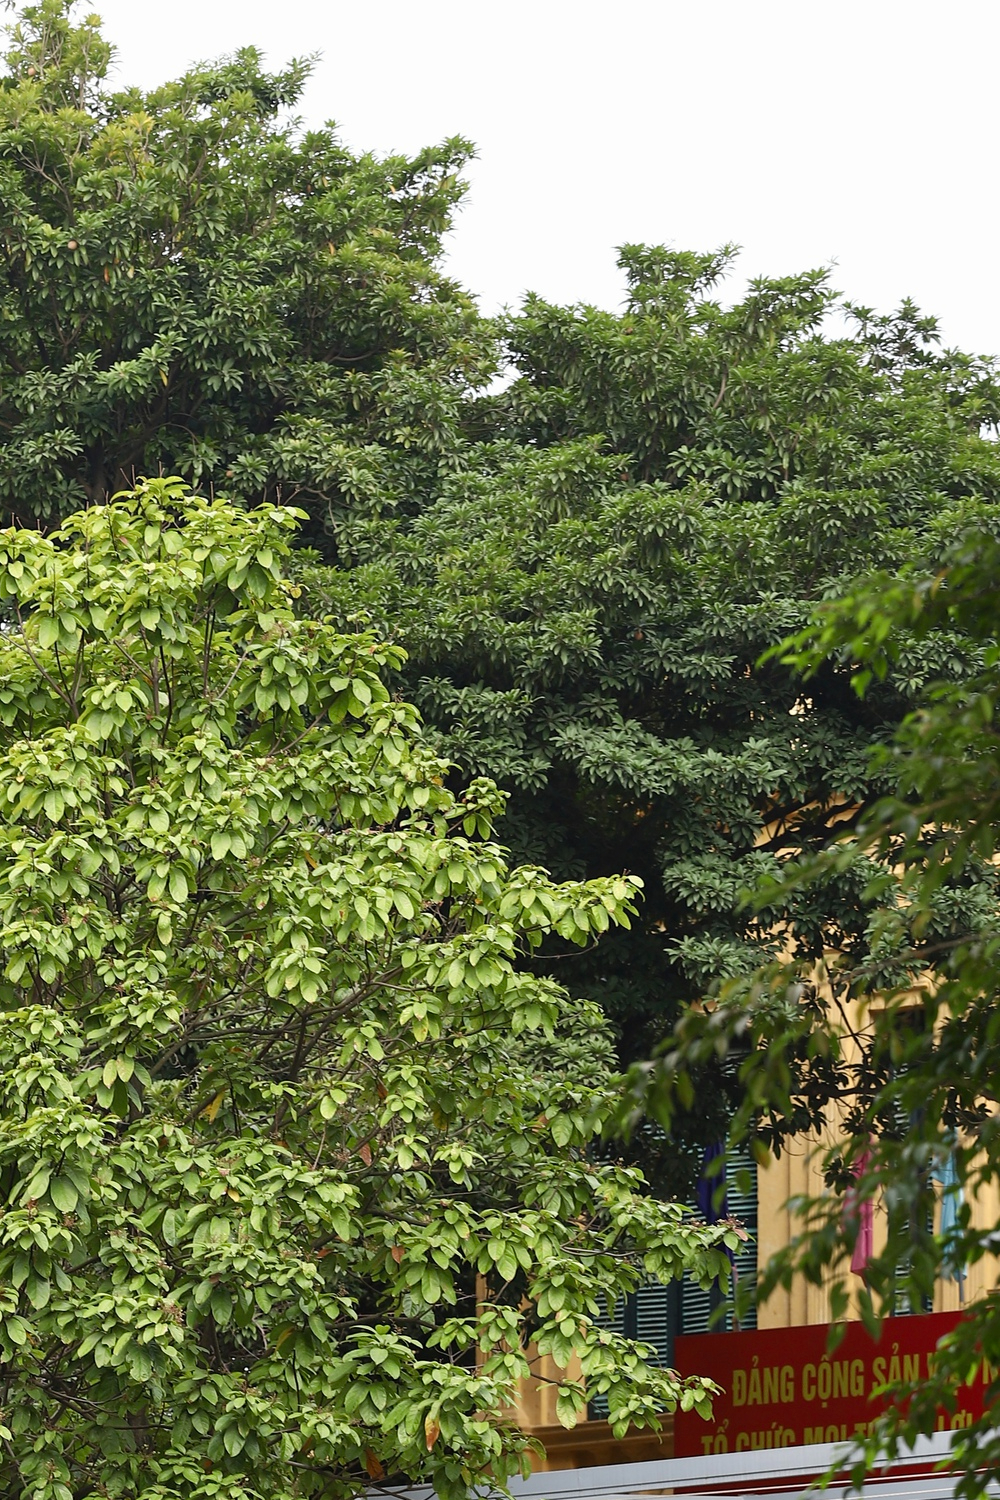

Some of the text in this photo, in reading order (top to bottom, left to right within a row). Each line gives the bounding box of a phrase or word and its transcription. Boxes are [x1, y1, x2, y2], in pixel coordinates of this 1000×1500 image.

[732, 1355, 794, 1407] ĐẢNG
[802, 1354, 865, 1409] CỘNG
[871, 1342, 920, 1392] SẢN
